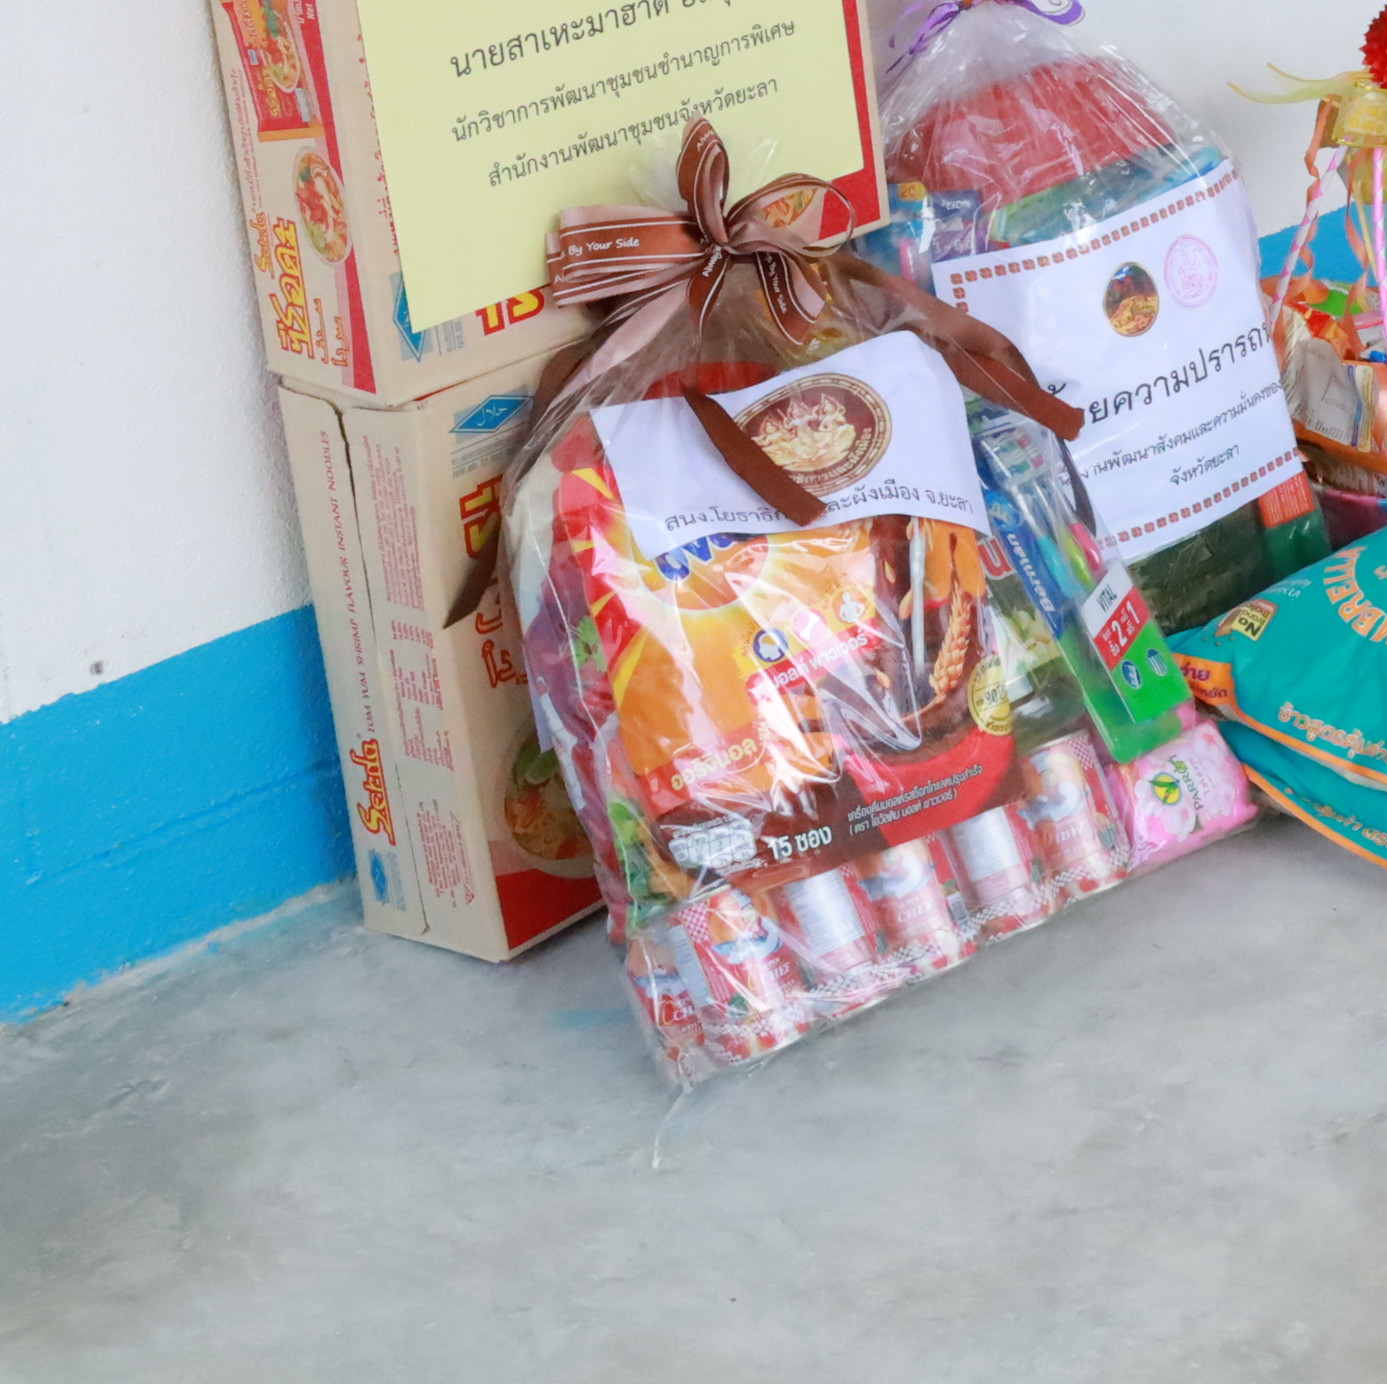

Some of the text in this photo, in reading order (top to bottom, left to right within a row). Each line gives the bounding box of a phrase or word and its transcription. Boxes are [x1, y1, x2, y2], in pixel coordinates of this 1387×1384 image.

[451, 18, 797, 143] นักวิชาการพัฒนาชุมชนชำนาญการพิเศษ
[488, 77, 780, 188] สำนักงานพัฒนาชุมชนจังหวัดยะลา
[567, 236, 640, 257] By Your Side
[320, 430, 337, 492] NOODLES
[1169, 443, 1241, 487] จังหวัดยะลา
[330, 497, 346, 551] INSTANT
[924, 487, 975, 515] จ.ยะลา
[340, 556, 358, 614] FLAVOUR
[1096, 584, 1119, 613] VITAL
[350, 618, 365, 666] SHRIMP
[1111, 600, 1141, 648] 2 1
[358, 671, 370, 700] YUM
[364, 704, 376, 733] TOM
[1166, 753, 1205, 811] PARROT
[767, 836, 793, 861] 15
[796, 824, 833, 854] ซอง
